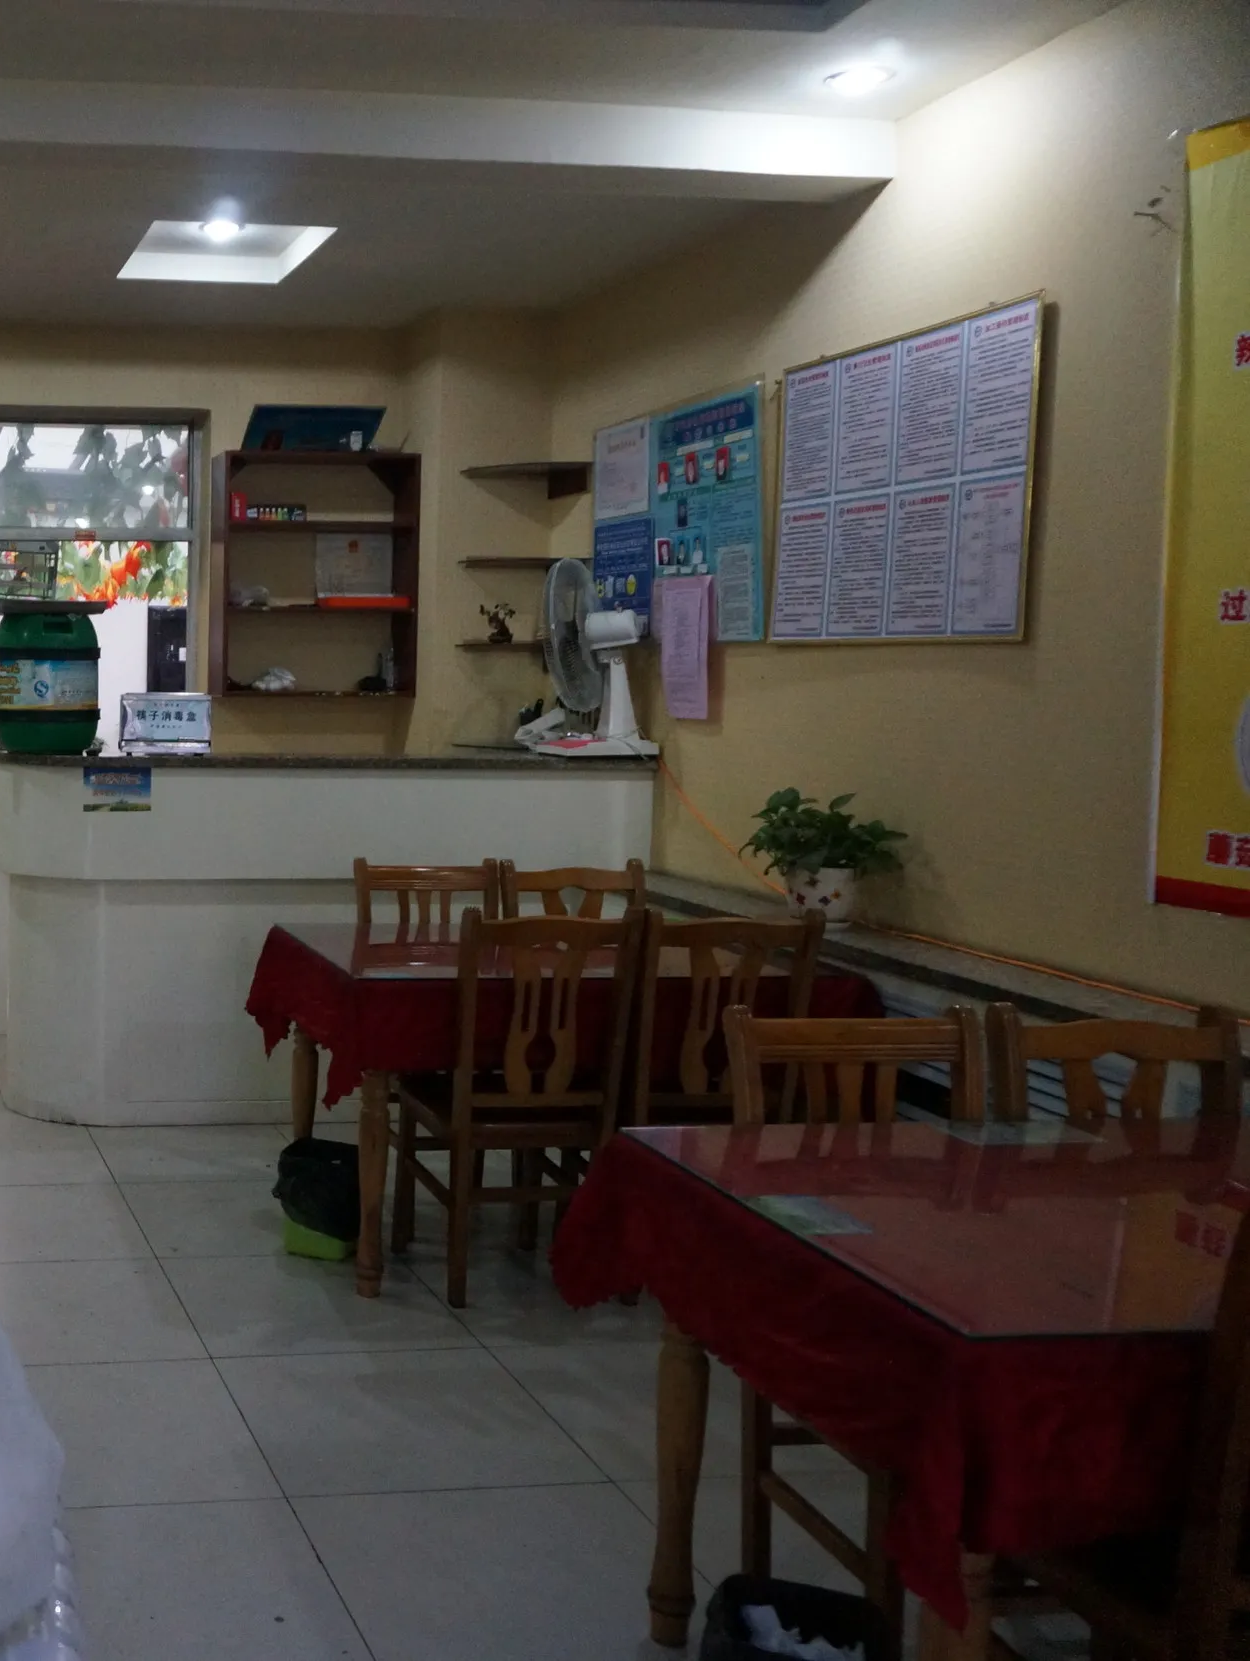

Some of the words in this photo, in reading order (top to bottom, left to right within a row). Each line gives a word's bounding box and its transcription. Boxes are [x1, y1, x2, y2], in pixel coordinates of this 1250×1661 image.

[136, 709, 197, 723] 筷子消毒盒
